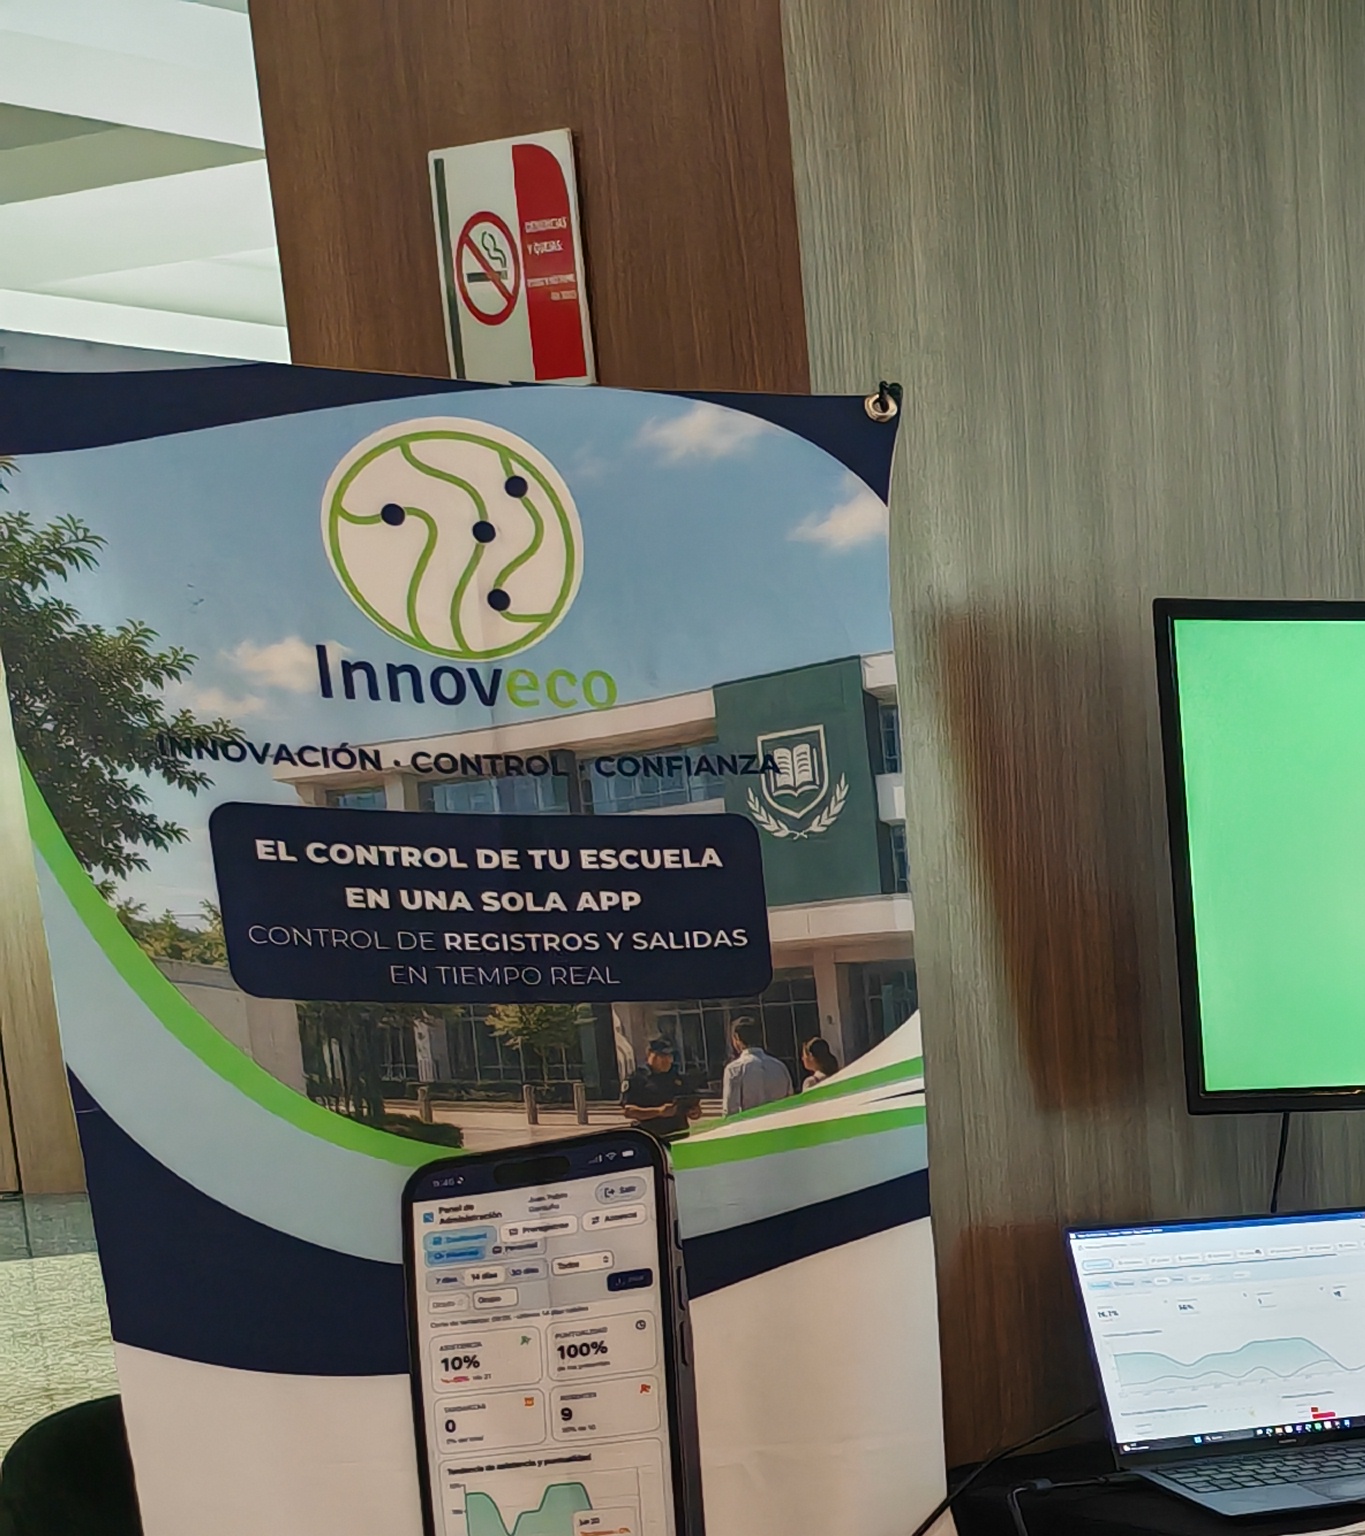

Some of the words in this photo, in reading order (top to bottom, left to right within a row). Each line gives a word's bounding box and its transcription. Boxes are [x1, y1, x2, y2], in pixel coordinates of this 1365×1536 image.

[315, 644, 618, 709] Innoveco
[157, 736, 382, 771] INNOVACIÓN
[411, 751, 571, 777] CONTROL
[595, 753, 782, 778] CONFIANZA
[255, 838, 298, 862] EL
[305, 841, 468, 870] CONTROL
[476, 848, 521, 870] DE
[528, 848, 571, 870] TU
[580, 847, 724, 869] ESCUELA
[345, 886, 390, 910] EN
[399, 889, 474, 912] UNA
[482, 891, 568, 912] SOLA
[576, 890, 642, 912] APP
[248, 925, 391, 950] CONTROL
[398, 930, 436, 951] DE
[444, 931, 600, 952] REGISTROS
[606, 931, 625, 950] Y
[632, 928, 749, 949] SALIDAS
[390, 964, 429, 986] EN
[436, 966, 542, 986] TIEMPO
[551, 965, 621, 985] REAL
[557, 1340, 608, 1360] 100%
[440, 1355, 480, 1372] 10%
[445, 1419, 456, 1433] 0
[561, 1407, 573, 1421] 9
